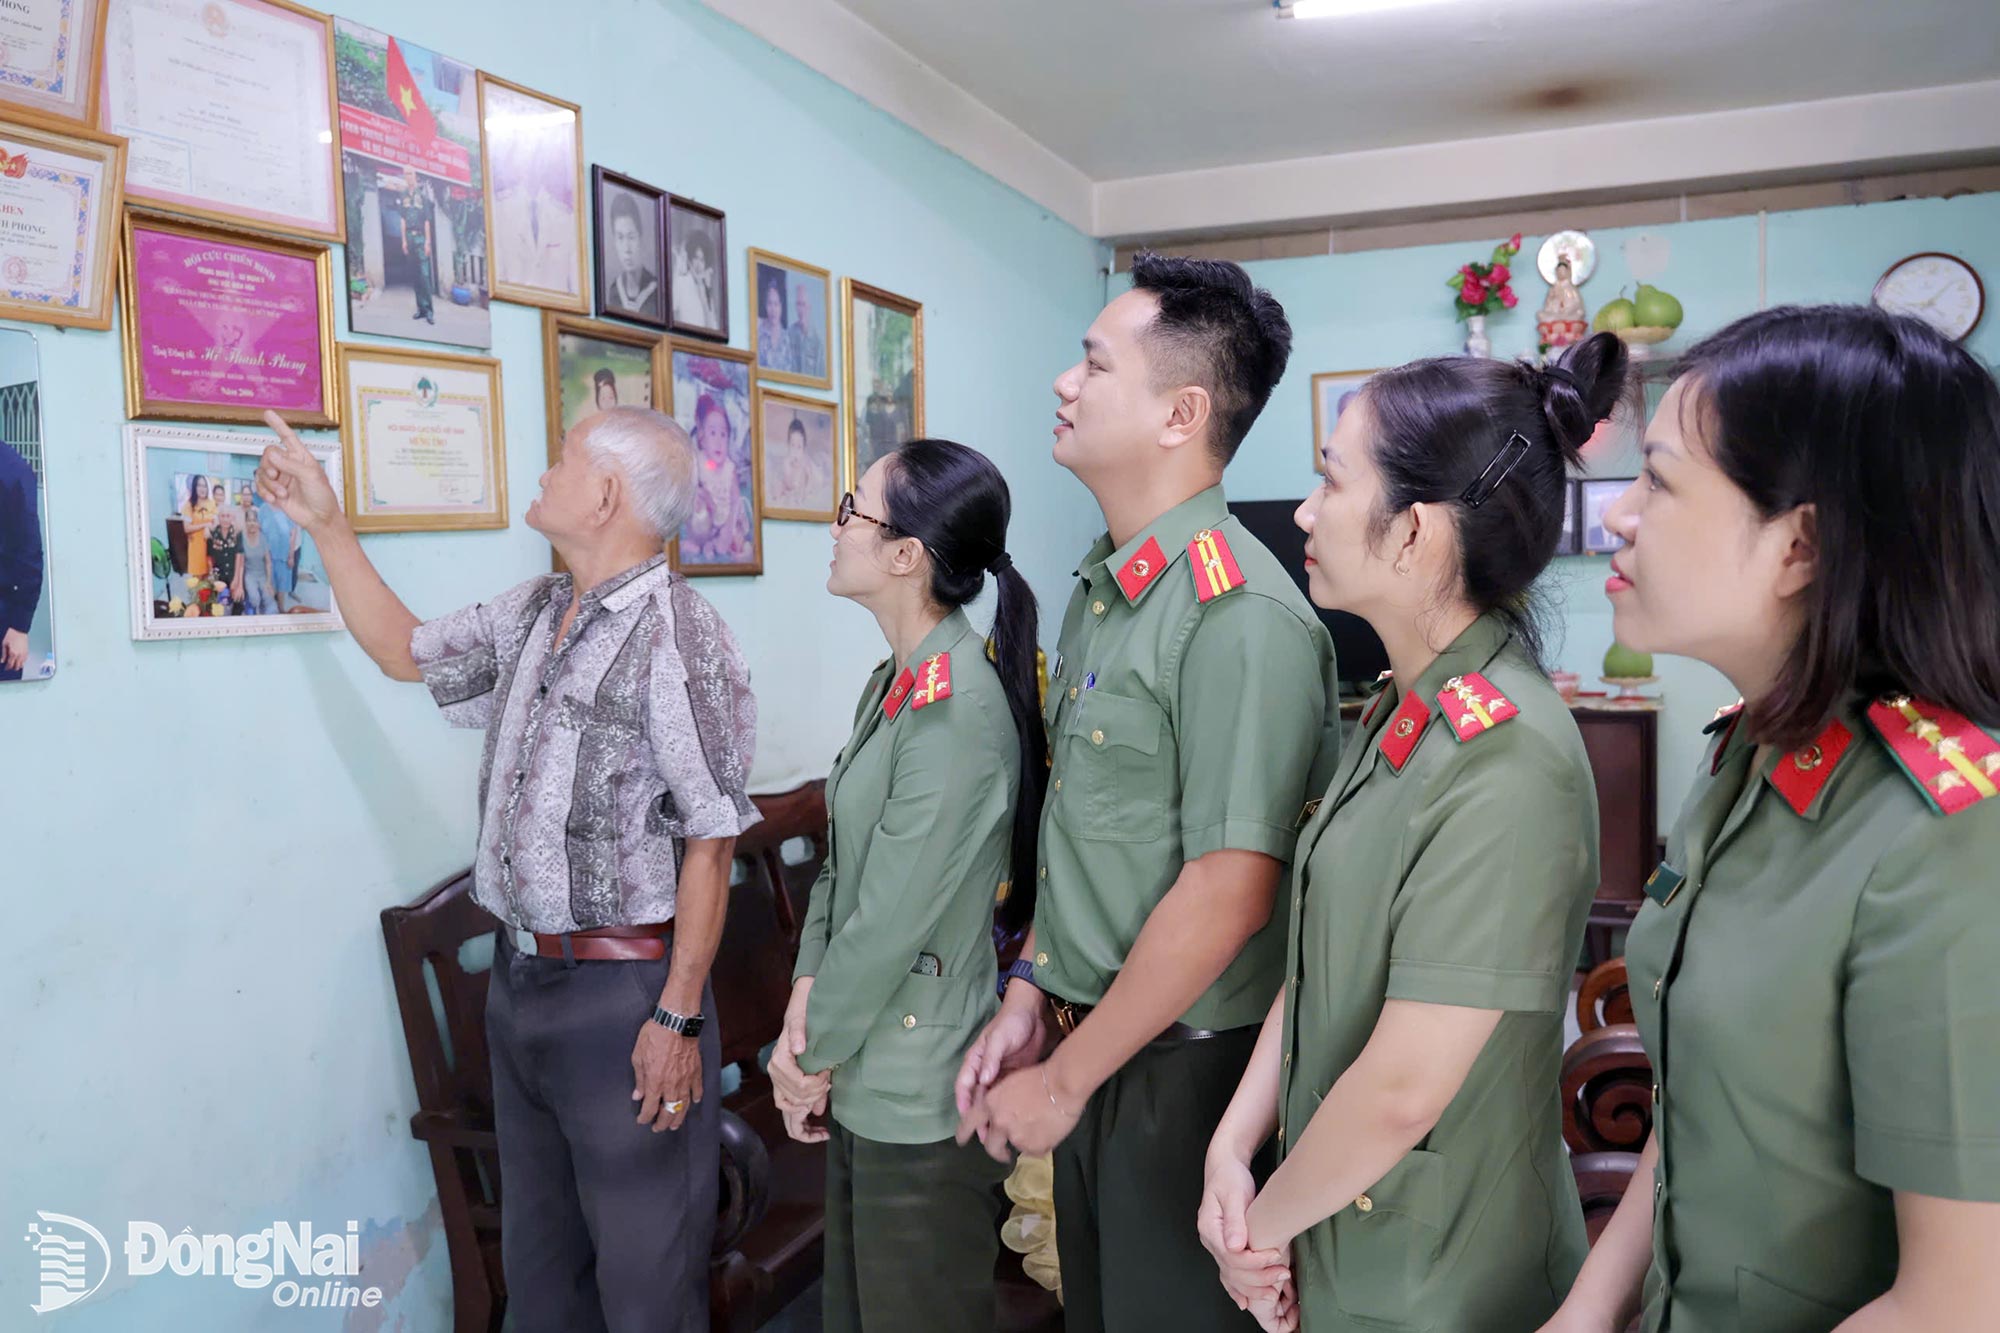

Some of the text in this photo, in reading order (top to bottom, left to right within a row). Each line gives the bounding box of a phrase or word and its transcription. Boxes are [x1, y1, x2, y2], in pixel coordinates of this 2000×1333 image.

[0, 0, 30, 14] HONG
[0, 204, 24, 215] HEN
[11, 221, 47, 235] PHONG
